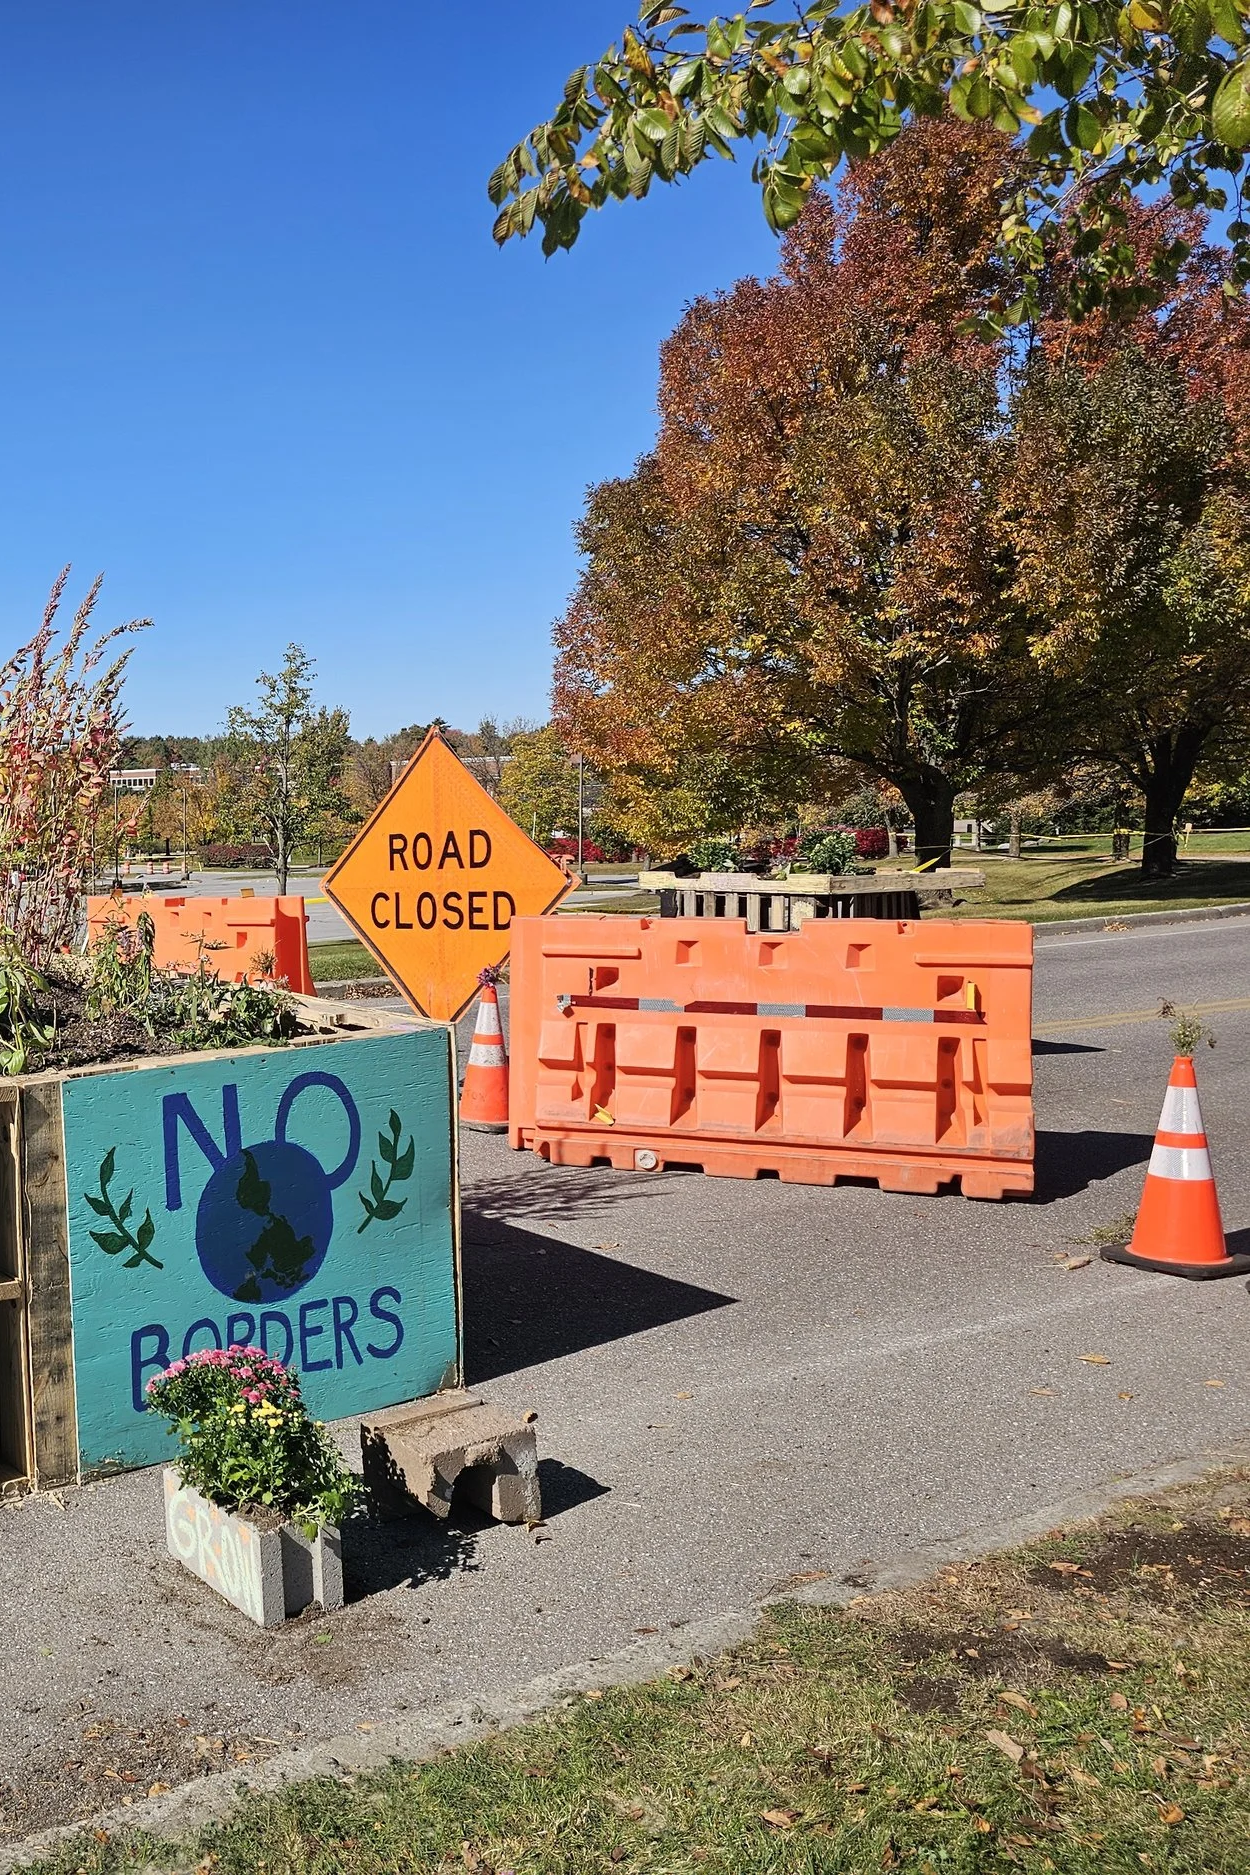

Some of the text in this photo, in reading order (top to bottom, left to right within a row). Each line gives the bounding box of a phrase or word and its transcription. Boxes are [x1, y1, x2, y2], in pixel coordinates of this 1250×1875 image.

[388, 829, 492, 871] ROAD
[370, 891, 516, 930] CLOSED
[162, 1071, 361, 1210] NO
